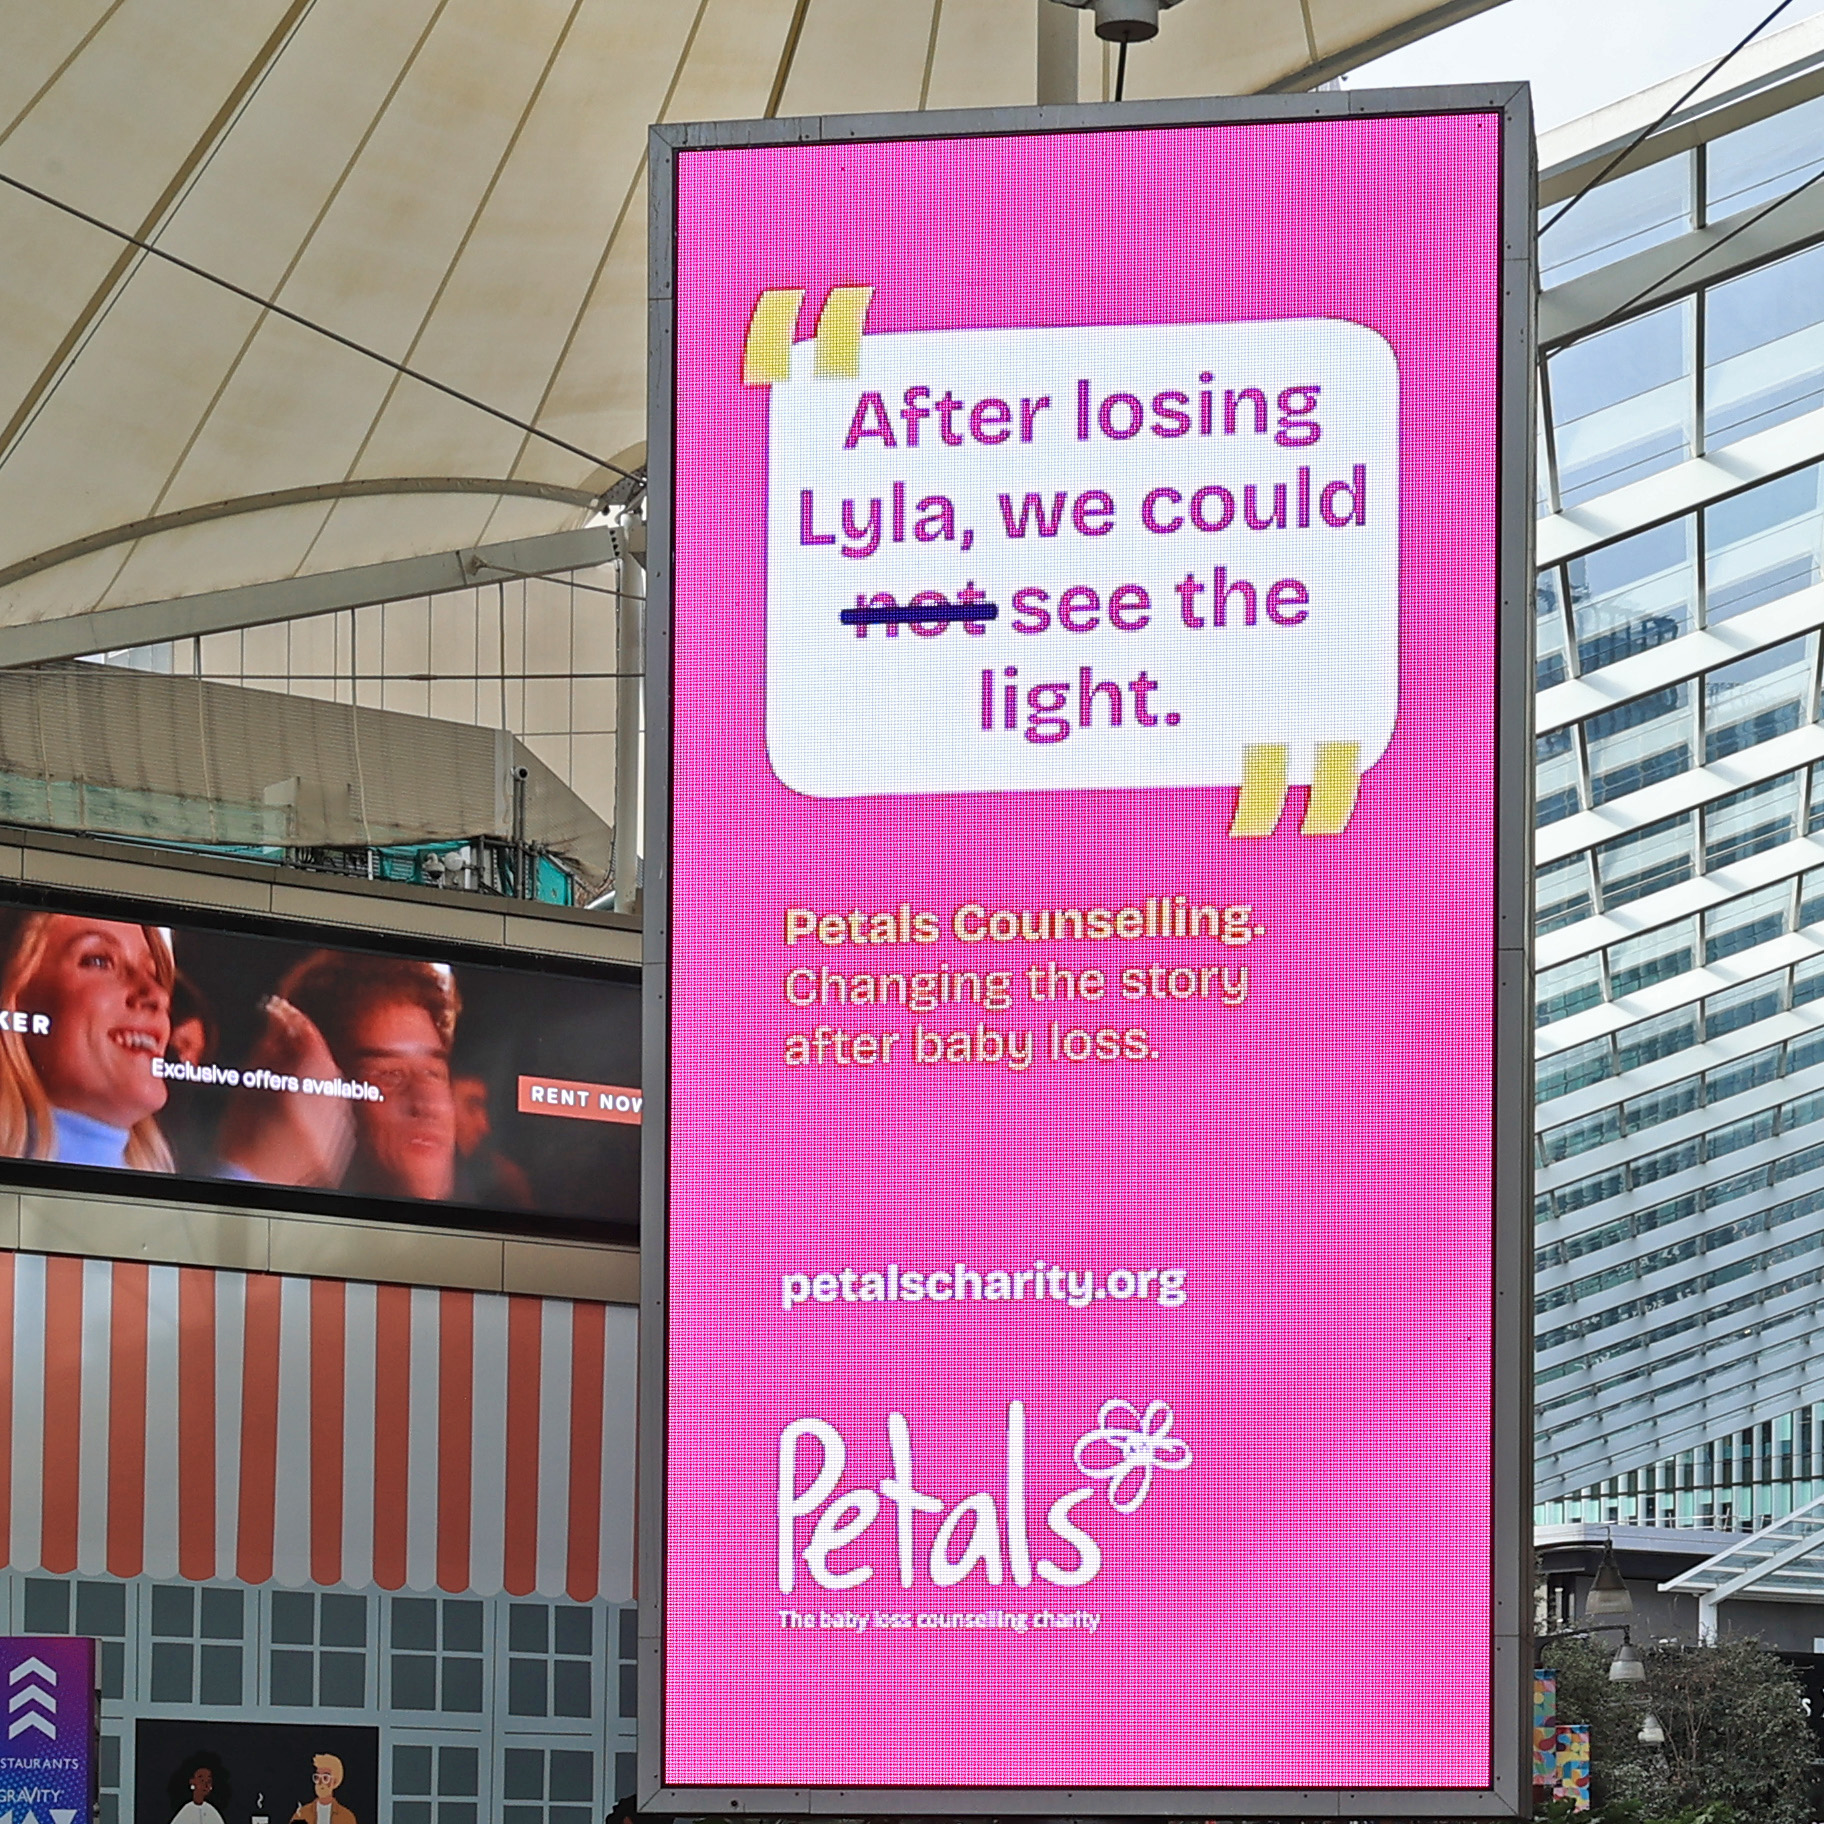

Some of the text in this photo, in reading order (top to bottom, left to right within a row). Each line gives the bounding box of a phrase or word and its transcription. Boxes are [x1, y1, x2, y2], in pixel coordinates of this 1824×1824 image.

[842, 370, 1322, 451] After losing
[798, 463, 1370, 560] Lyla, we could
[853, 566, 1311, 639] not see the
[979, 665, 1182, 745] light.
[784, 896, 1266, 947] Petals Counselling.
[785, 960, 1250, 1013] Changing the story
[784, 1020, 1161, 1071] after baby loss.
[151, 1057, 385, 1103] Exclusive offers available.
[531, 1085, 590, 1108] RENT
[782, 1259, 1188, 1310] petalscharity.org
[777, 1399, 1102, 1595] Petals
[778, 1610, 1101, 1634] The baby loss counselling charity
